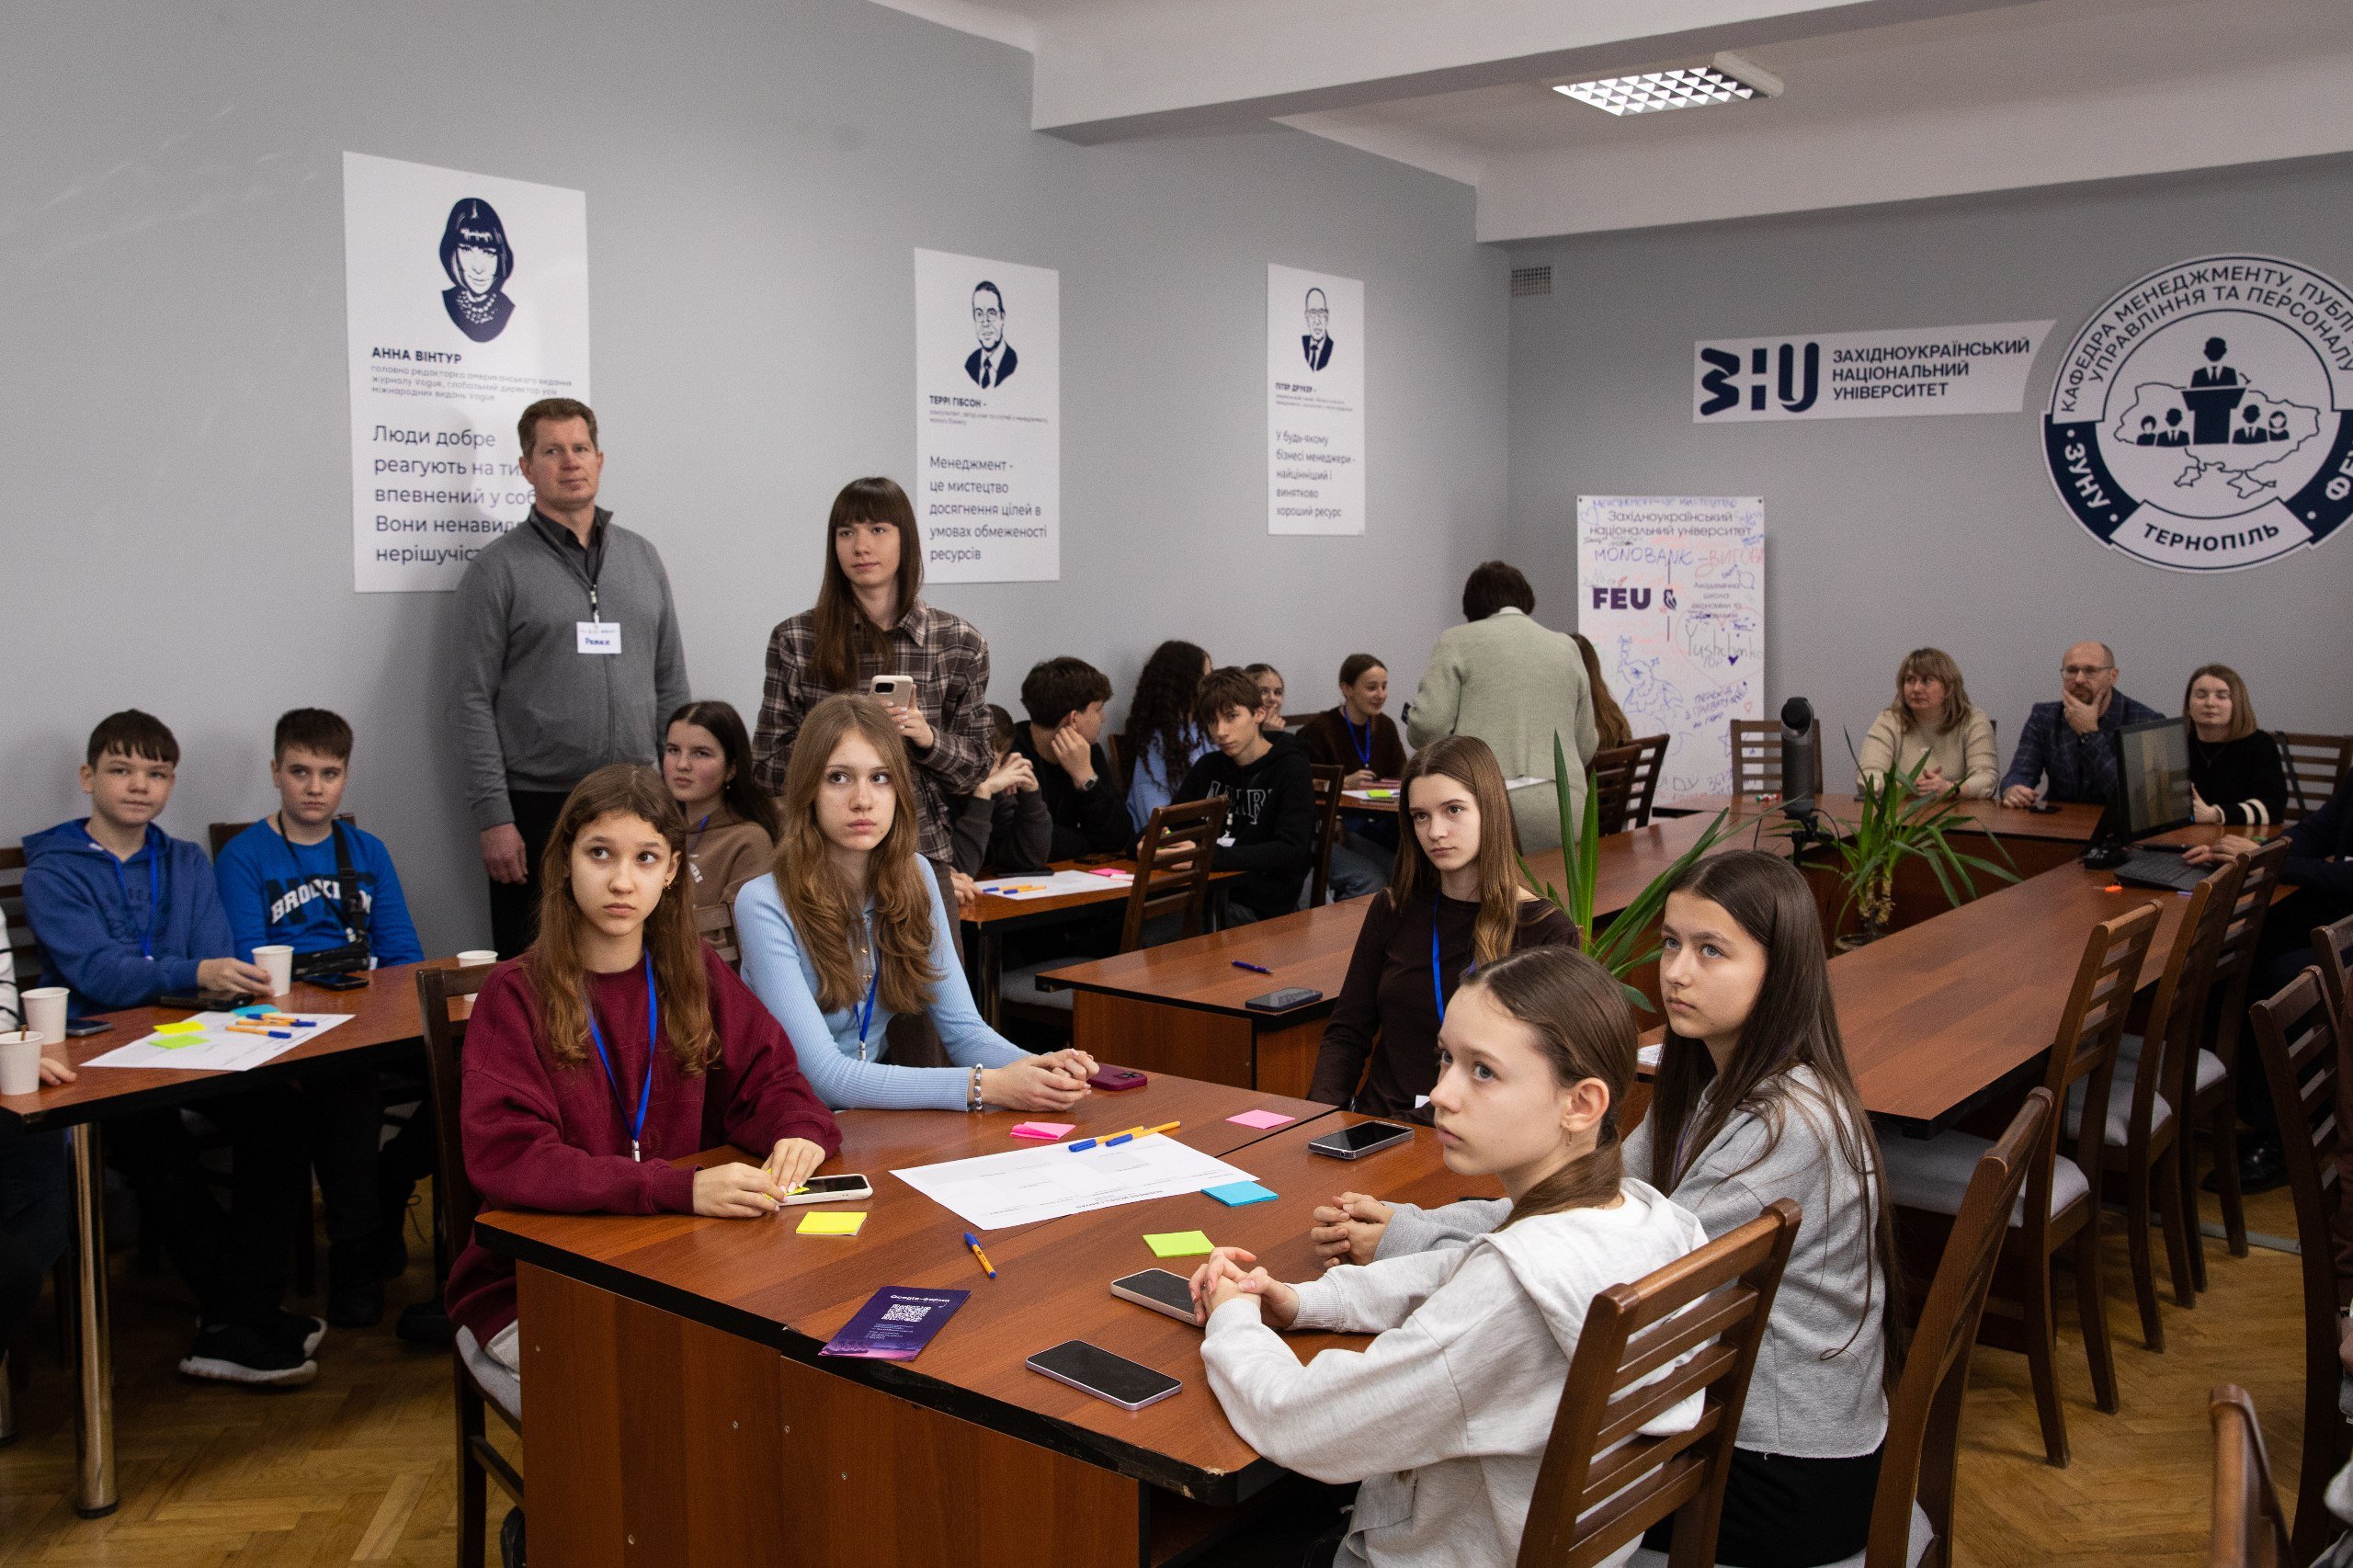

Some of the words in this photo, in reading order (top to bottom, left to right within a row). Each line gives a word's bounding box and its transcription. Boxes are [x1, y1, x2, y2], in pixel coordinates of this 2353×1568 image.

[2061, 324, 2116, 412] КАФЕДРА
[2115, 266, 2292, 322] МЕНЕДЖМЕНТУ,
[2089, 290, 2205, 382] УПРАВЛІННЯ
[2212, 286, 2240, 301] ТА
[2246, 287, 2353, 370] ПЕРСОНАЛУ
[371, 347, 411, 361] АННА
[415, 350, 462, 364] ВІНТУР
[1833, 336, 2030, 363] ЗАХІДНОУКРАЇНСЬКИЙ
[1832, 361, 1969, 381] НАЦІОНАЛЬНИЙ
[1833, 382, 1949, 401] УНІВЕРСИТЕТ
[373, 426, 430, 445] Люди
[436, 428, 495, 449] добре
[374, 459, 467, 477] реагують
[472, 462, 494, 475] на
[499, 463, 523, 476] ти
[929, 456, 1006, 471] Менеджмент
[2064, 443, 2112, 509] ЗУНУ
[929, 481, 945, 493] це
[948, 481, 1009, 494] мистецтво
[375, 488, 484, 504] впевнений
[490, 493, 500, 508] у
[506, 490, 536, 505] соб
[929, 503, 998, 516] досягнення
[1001, 502, 1032, 517] цілей
[1035, 505, 1041, 516] в
[1608, 510, 1733, 525] Західноукраїнський
[376, 516, 427, 532] Вони
[929, 525, 972, 540] умовах
[974, 524, 1047, 538] обмеженості
[1589, 525, 1674, 537] національний
[1677, 525, 1751, 539] університет
[2143, 522, 2280, 551] ТЕРНОПІЛЬ
[930, 547, 982, 562] ресурсів
[1593, 587, 1652, 610] FEU
